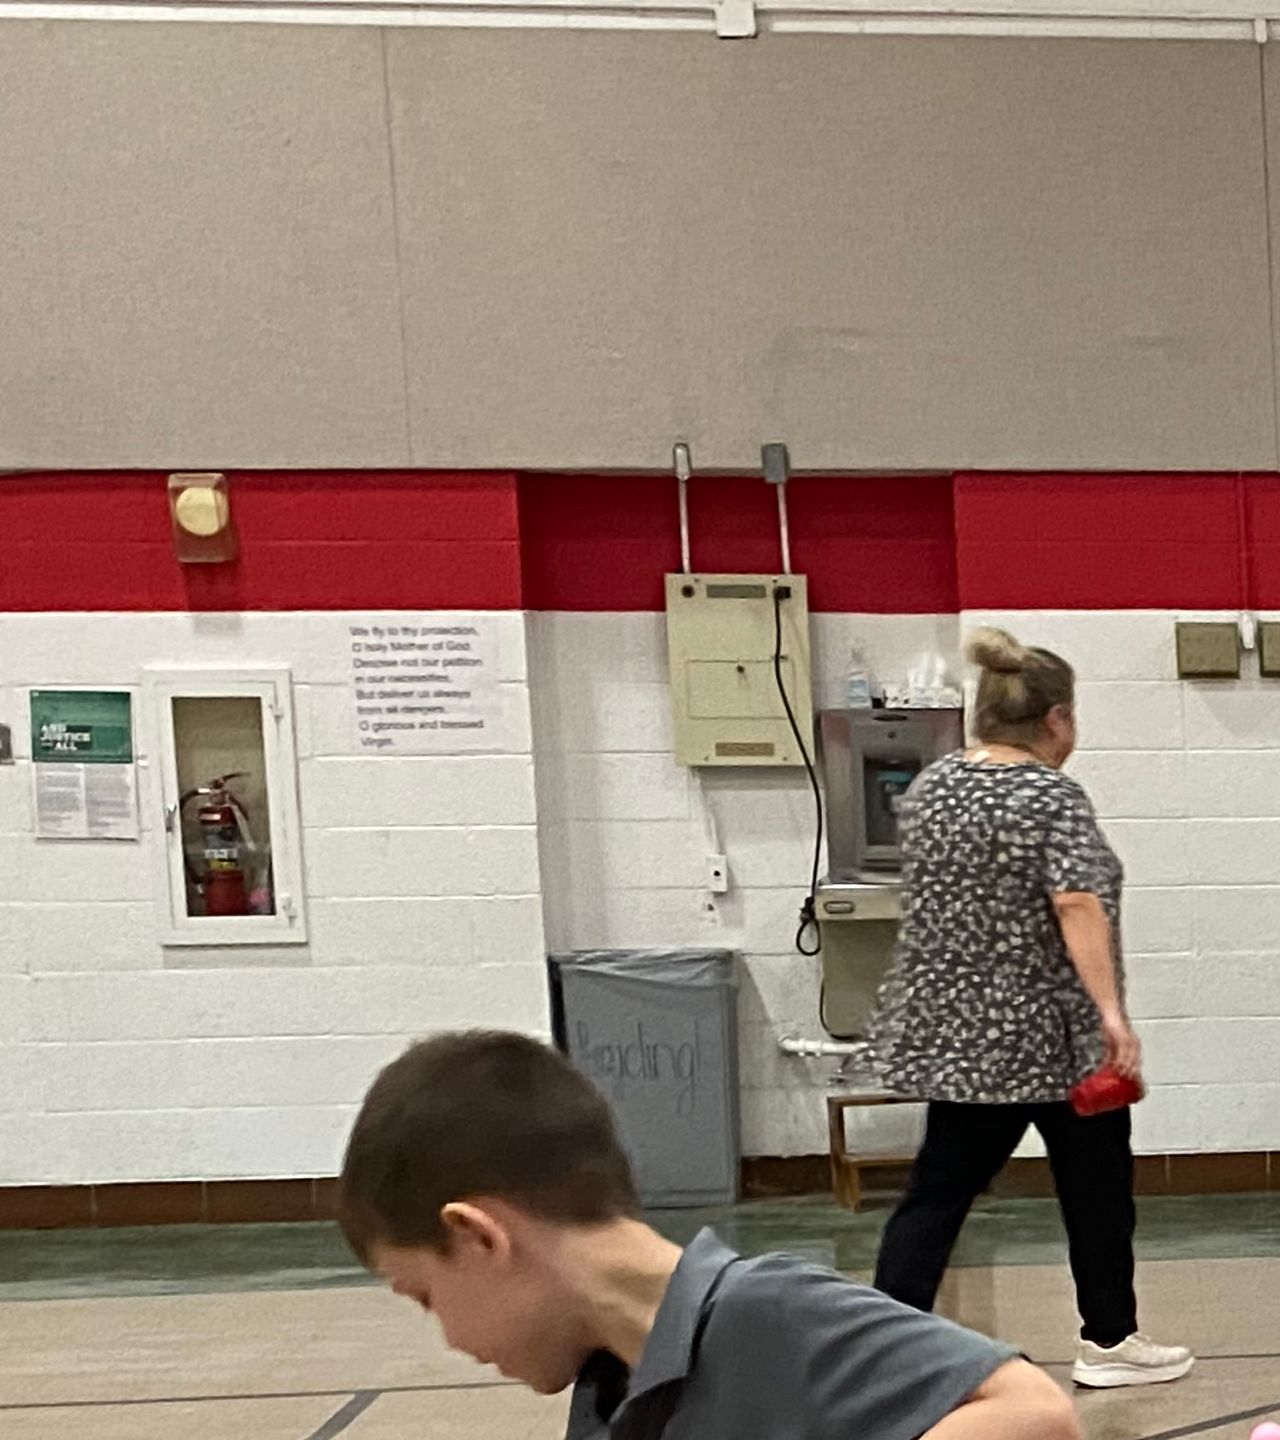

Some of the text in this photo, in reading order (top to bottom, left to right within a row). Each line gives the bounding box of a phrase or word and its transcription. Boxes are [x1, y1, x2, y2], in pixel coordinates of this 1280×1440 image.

[372, 626, 384, 638] fly
[388, 627, 398, 636] to
[401, 627, 417, 637] thy
[352, 643, 362, 652] O
[365, 643, 387, 653] holy
[390, 642, 428, 651] Mother
[432, 642, 443, 651] of
[356, 691, 375, 699] But
[378, 691, 413, 699] deliver
[433, 690, 471, 699] always
[359, 721, 369, 731] O
[419, 721, 437, 729] and
[55, 742, 77, 750] ALL
